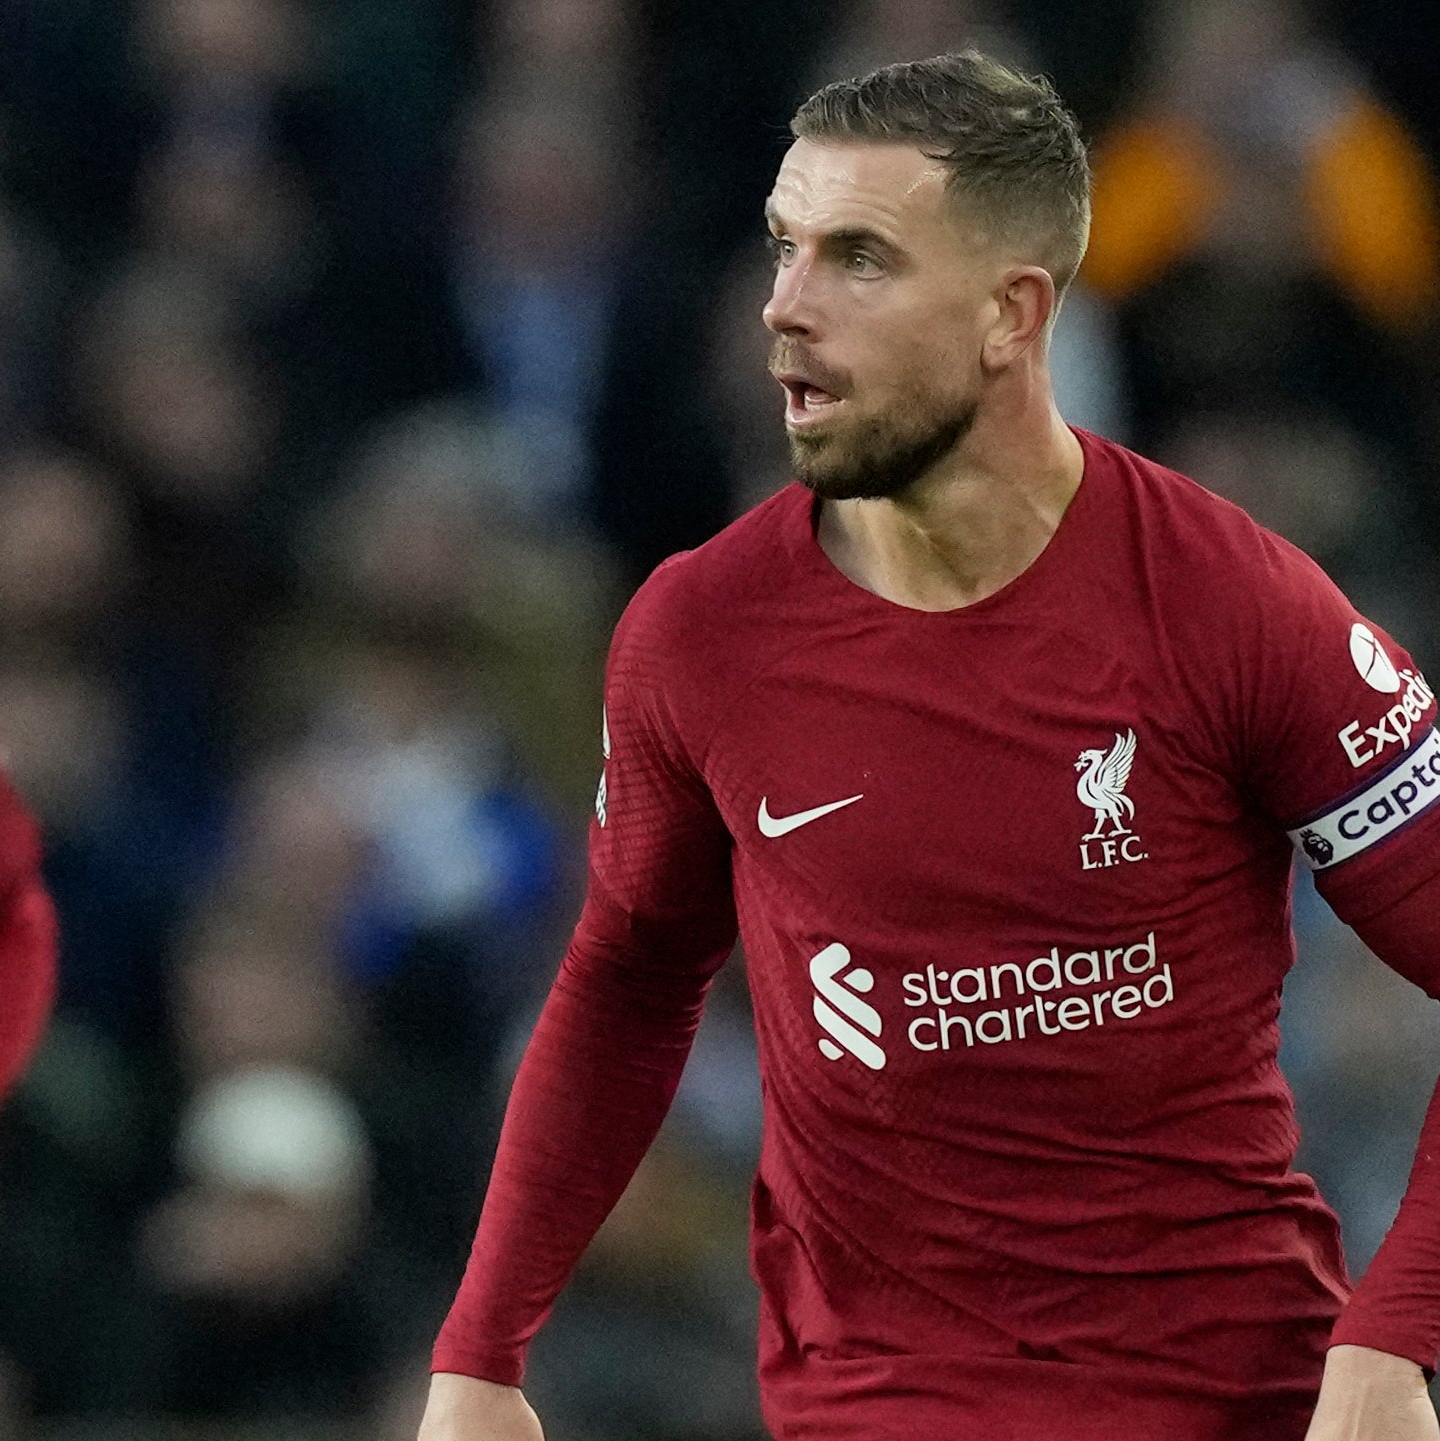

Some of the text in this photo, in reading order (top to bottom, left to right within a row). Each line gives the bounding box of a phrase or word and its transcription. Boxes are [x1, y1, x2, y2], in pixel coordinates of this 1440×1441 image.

[1338, 669, 1434, 768] Expedi
[1079, 836, 1149, 870] L.F.C.
[902, 931, 1157, 1007] standard
[908, 963, 1174, 1051] chartered
